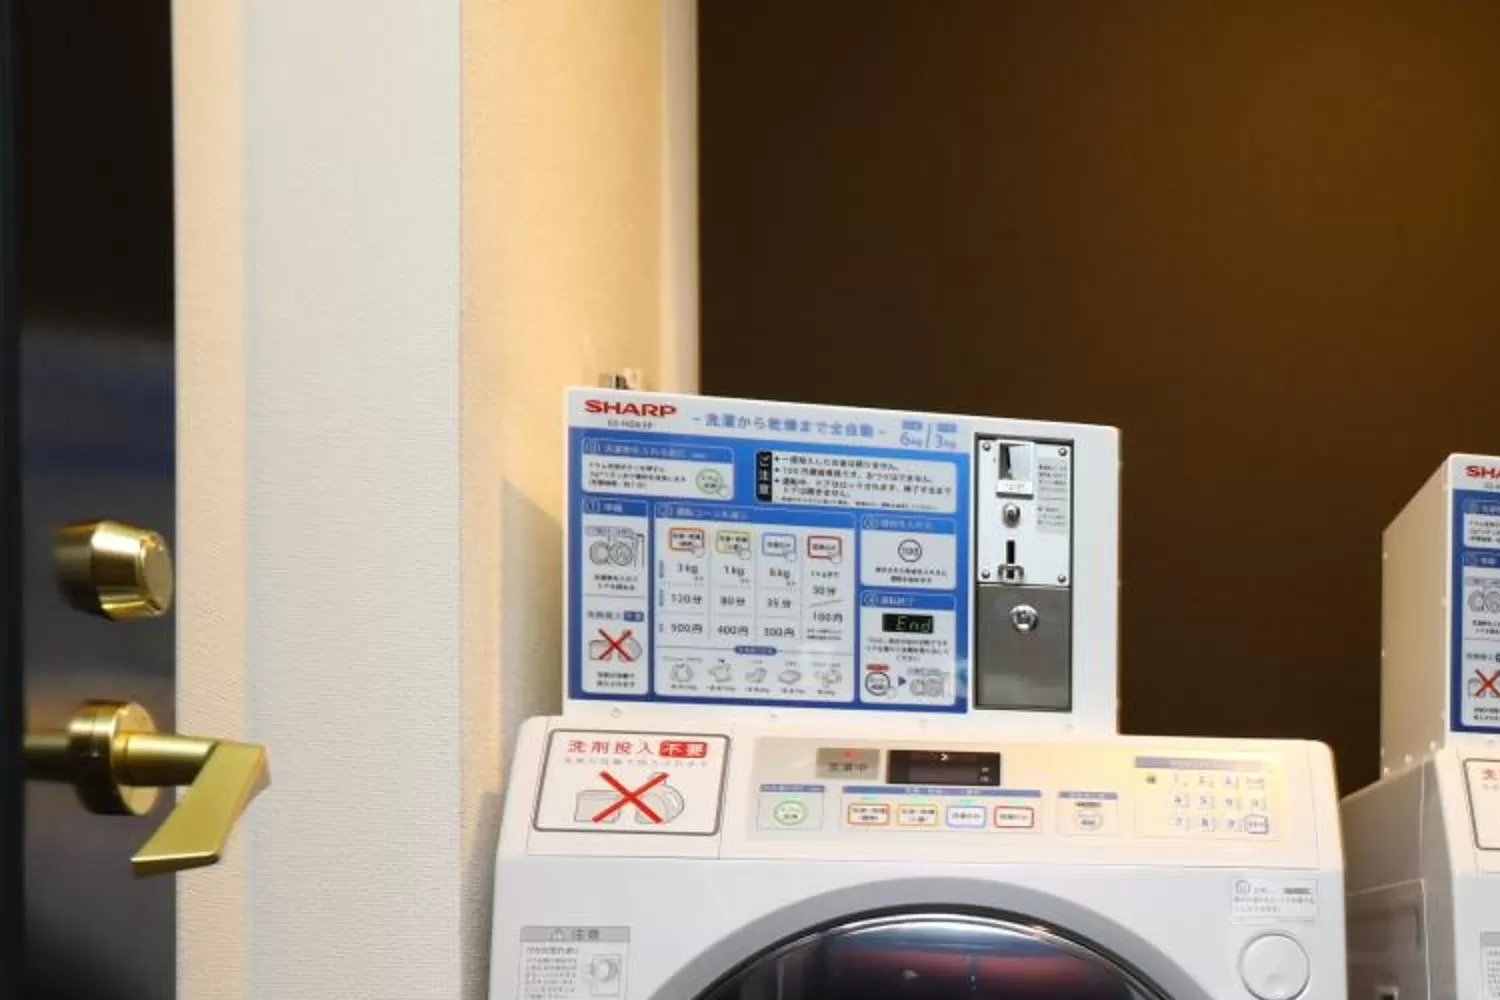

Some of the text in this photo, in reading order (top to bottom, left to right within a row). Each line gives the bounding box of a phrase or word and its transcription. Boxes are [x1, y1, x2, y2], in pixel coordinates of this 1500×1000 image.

[584, 399, 677, 417] SHARP
[567, 739, 655, 755] 洗剤投入
